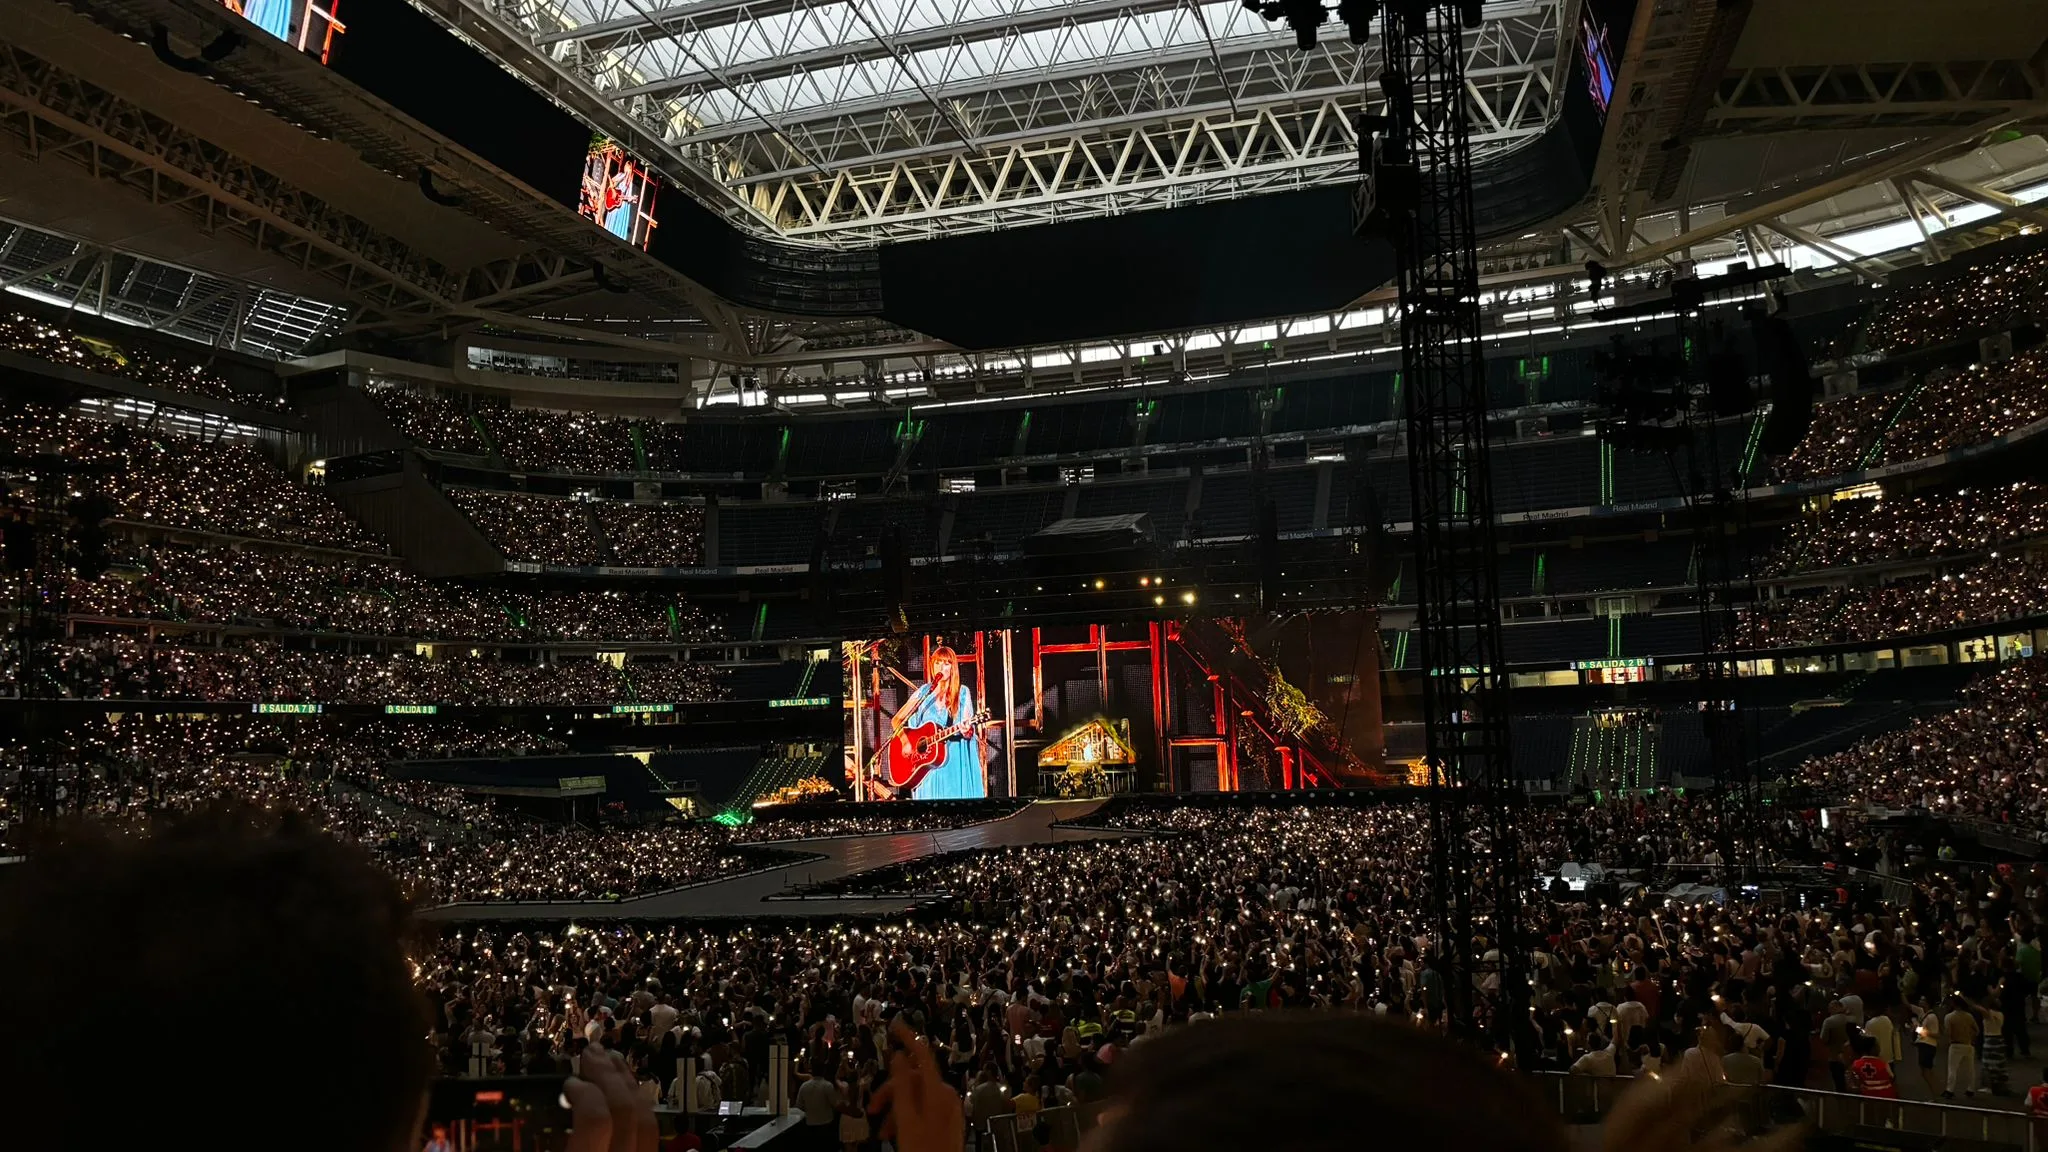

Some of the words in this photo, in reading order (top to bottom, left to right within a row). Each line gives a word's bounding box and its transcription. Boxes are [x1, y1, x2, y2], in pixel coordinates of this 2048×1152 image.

[1613, 504, 1630, 512] Real
[1631, 502, 1658, 510] Madrid
[1541, 511, 1569, 519] Madrid
[1290, 531, 1313, 539] Madrid
[625, 568, 649, 576] Madrid
[1590, 659, 1625, 668] SALIDA
[1628, 659, 1634, 667] 2
[779, 699, 811, 707] SALIDA
[269, 704, 299, 713] SALIDA
[302, 704, 307, 713] 7
[395, 705, 421, 714] SALIDA
[624, 705, 654, 713] SALIDA
